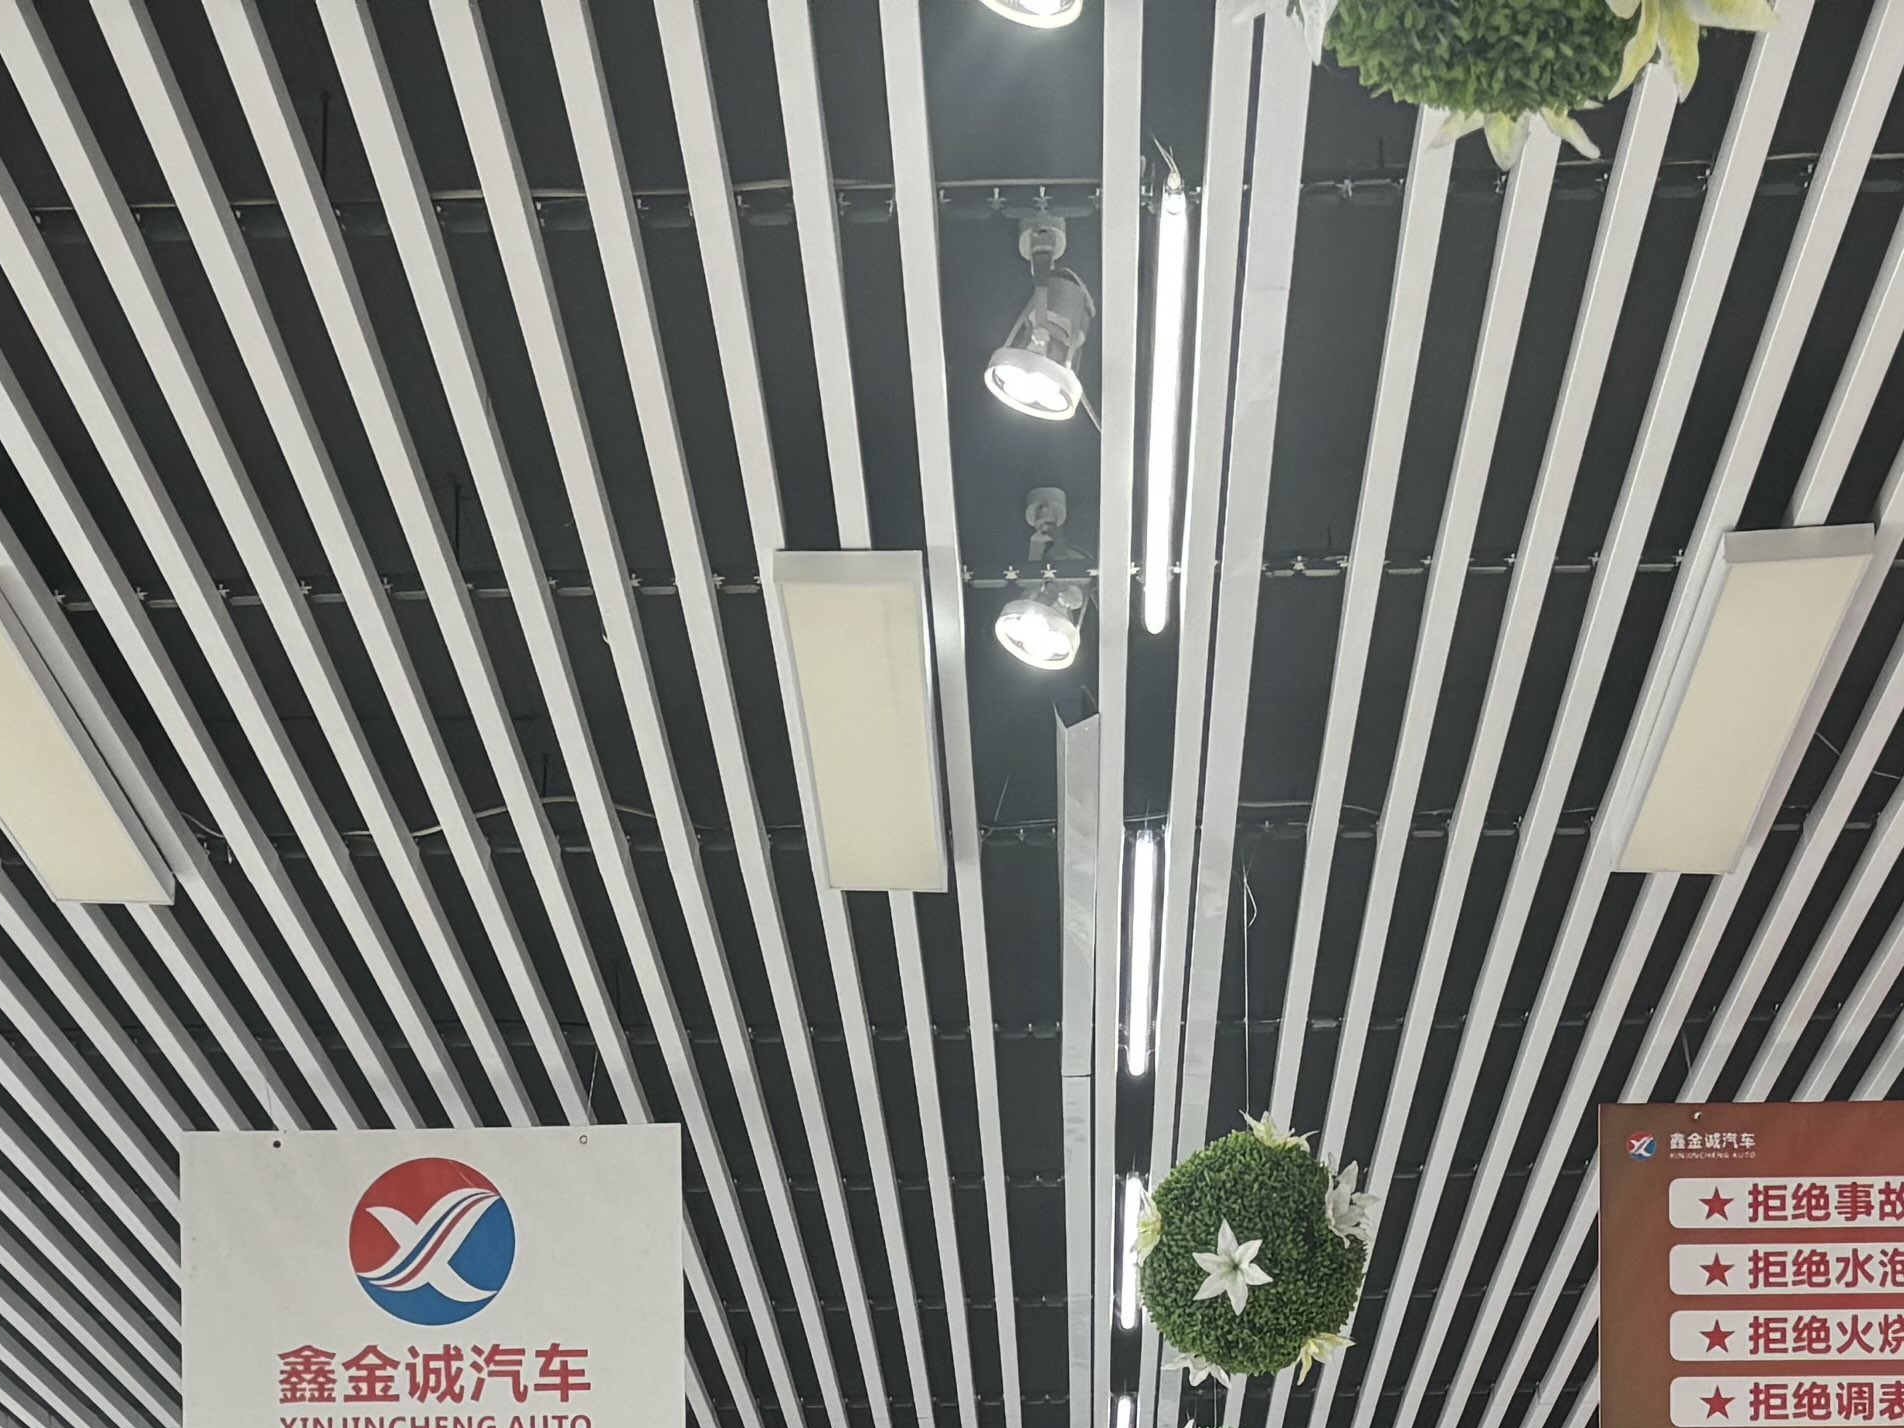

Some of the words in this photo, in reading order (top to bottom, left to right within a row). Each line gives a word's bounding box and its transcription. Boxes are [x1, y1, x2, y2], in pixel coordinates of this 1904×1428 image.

[1669, 1132, 1756, 1150] 鑫金诚汽车
[278, 1343, 591, 1404] 鑫金诚汽车
